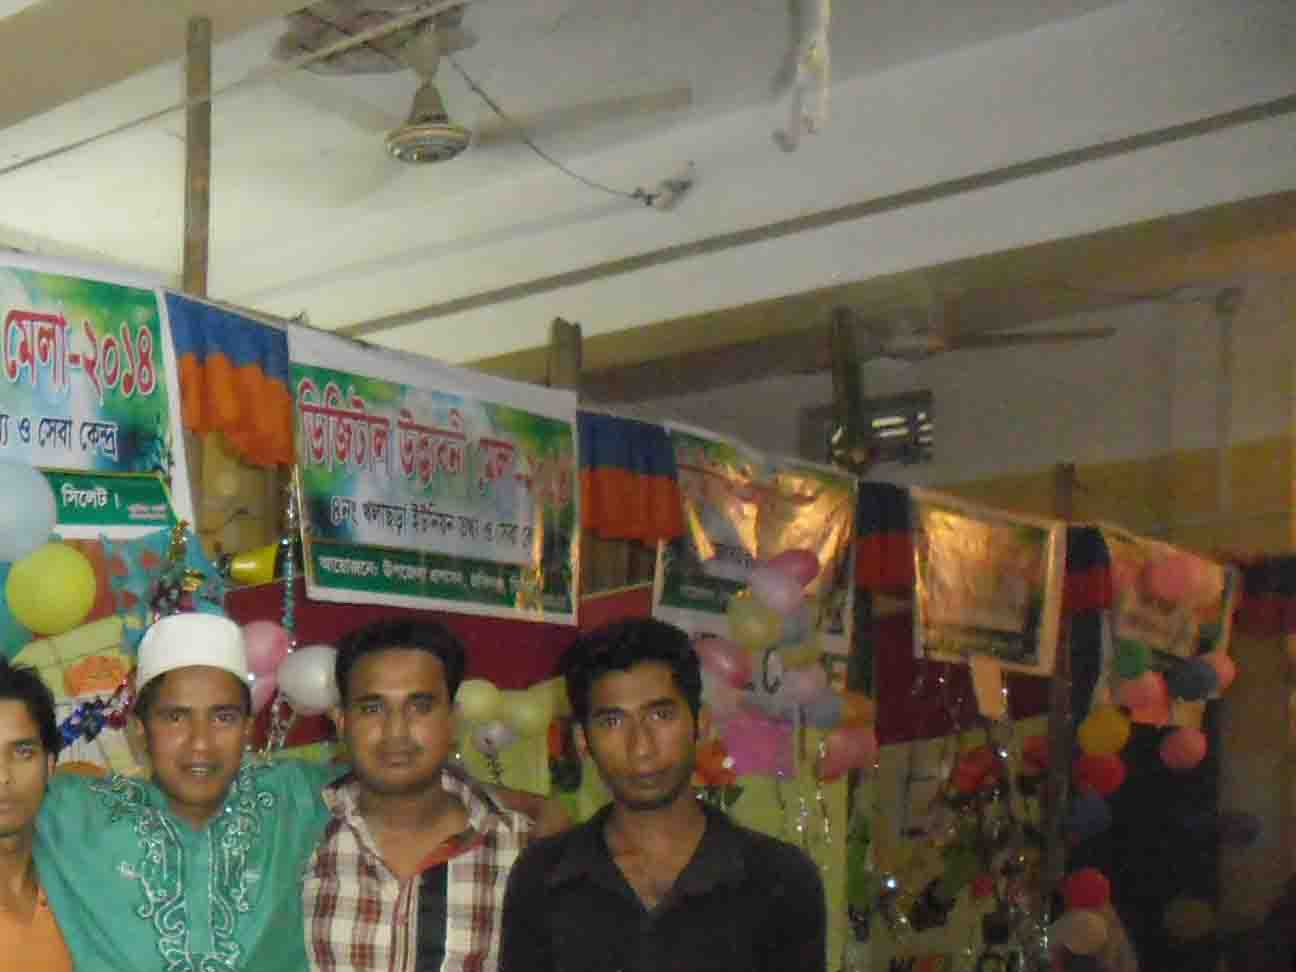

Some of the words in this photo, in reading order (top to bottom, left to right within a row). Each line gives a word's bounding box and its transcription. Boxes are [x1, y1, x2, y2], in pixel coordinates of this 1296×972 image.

[5, 309, 154, 398] মেলা-২০১৪
[18, 416, 31, 442] ও
[39, 416, 73, 449] সেবা
[299, 378, 390, 474] ডিজিটাল
